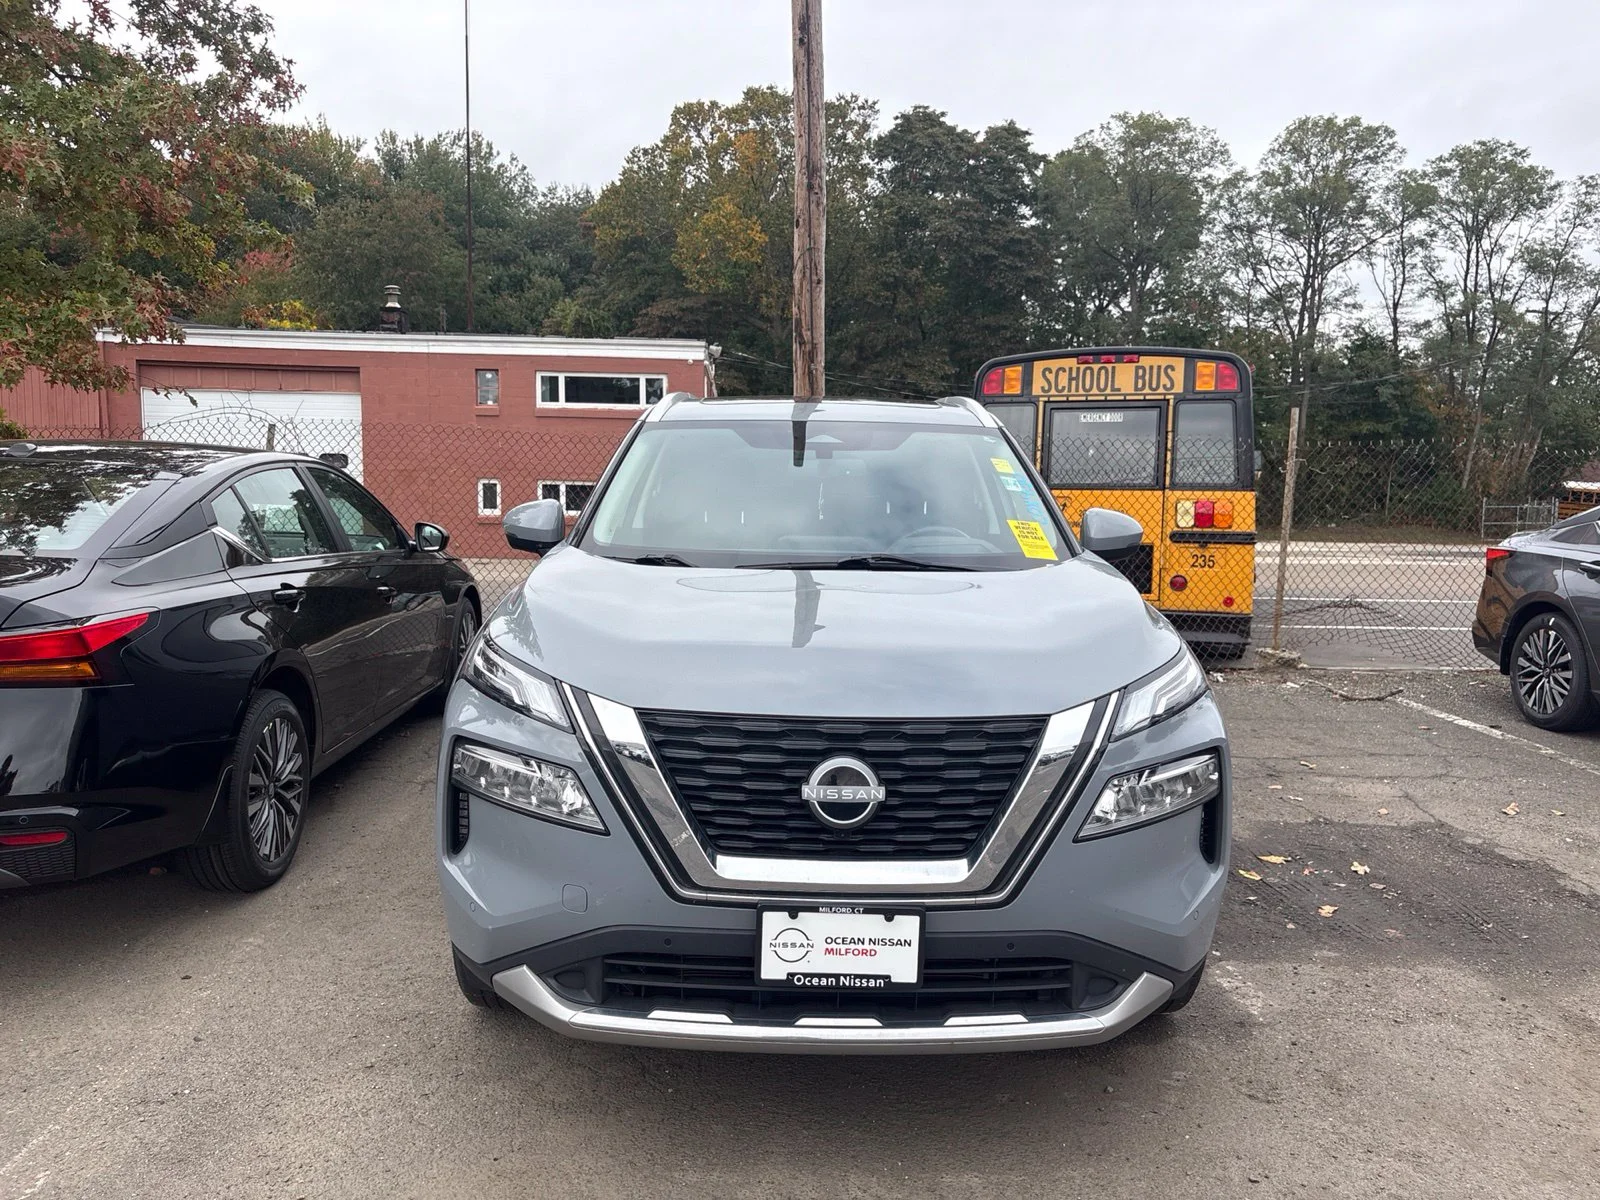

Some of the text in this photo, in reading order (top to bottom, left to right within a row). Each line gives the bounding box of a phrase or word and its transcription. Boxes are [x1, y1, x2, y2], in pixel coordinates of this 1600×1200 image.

[1040, 364, 1176, 394] SCHOOL BUS
[1191, 554, 1215, 569] 235
[804, 787, 883, 800] NISSAN
[769, 940, 814, 949] NISSAN
[824, 936, 912, 947] OCEAN NISSAN
[824, 947, 877, 957] MILFORD
[793, 974, 885, 988] Ocean Nissan
